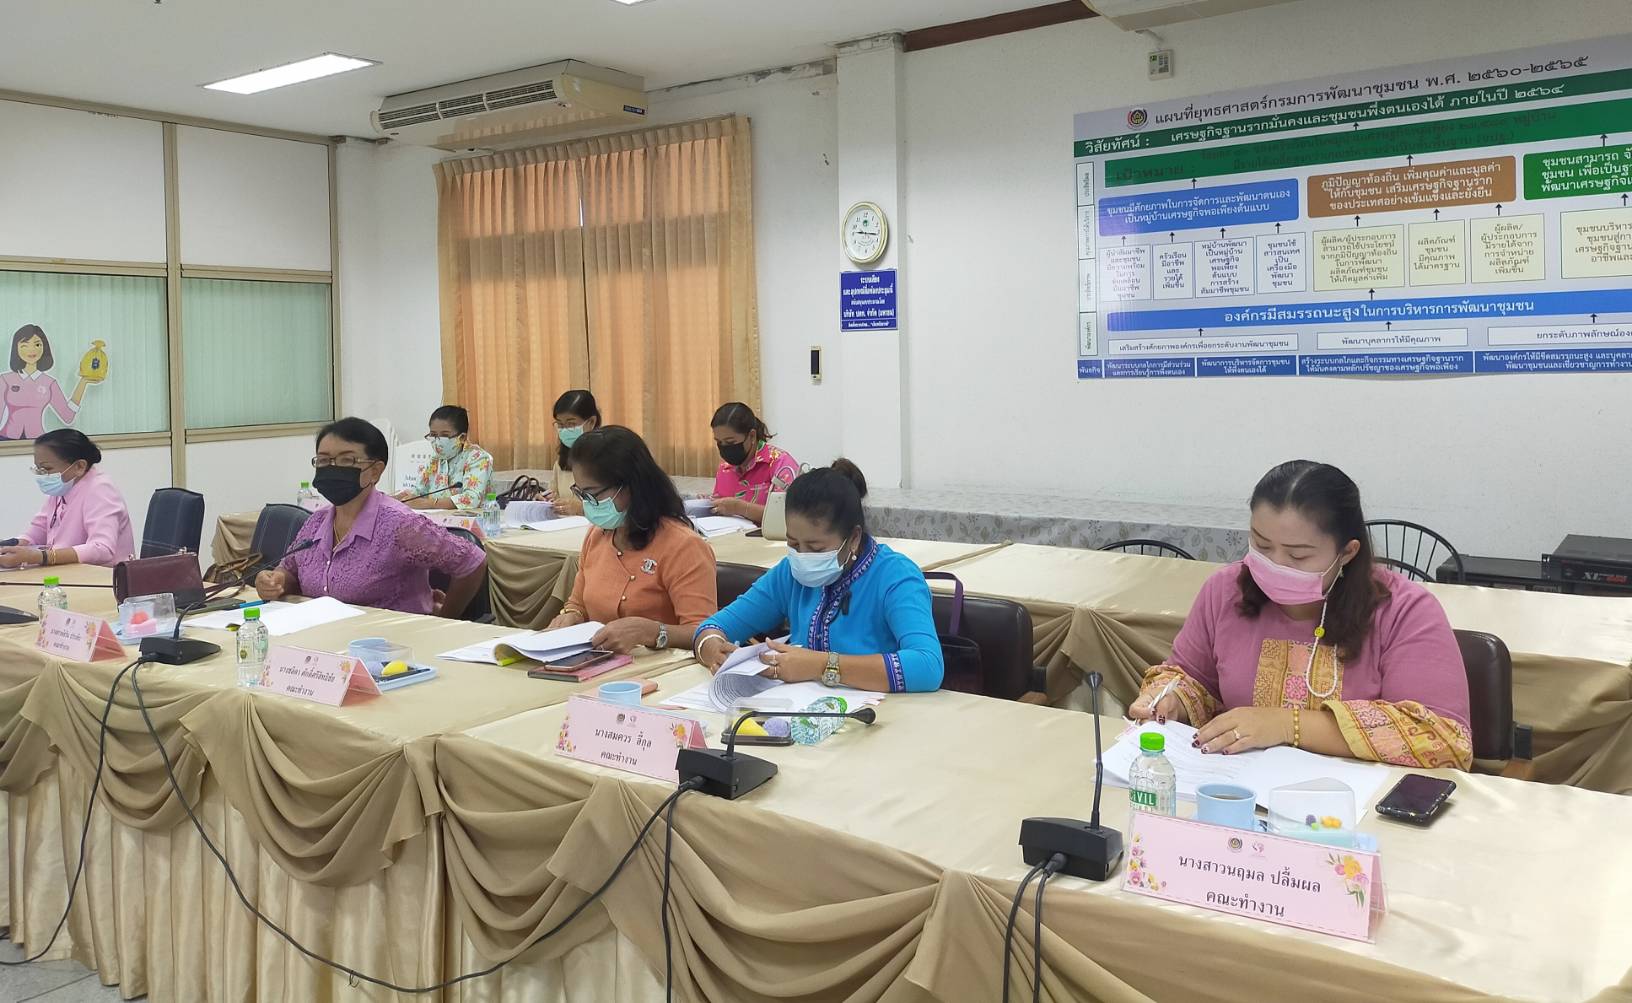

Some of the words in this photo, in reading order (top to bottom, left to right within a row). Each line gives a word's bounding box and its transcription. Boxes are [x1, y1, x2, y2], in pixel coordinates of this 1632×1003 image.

[1426, 73, 1461, 88] พ.ศ.
[1085, 136, 1141, 154] วิสัยทัศน์
[1450, 88, 1508, 107] ภายในปี
[1514, 83, 1565, 99] ๒๕๖๔
[600, 751, 638, 765] คณะทำงาน
[1179, 853, 1265, 882] นางสาวนฤมล
[1270, 867, 1321, 893] ปลื้มผล
[1206, 889, 1285, 918] คณะทำงาน
